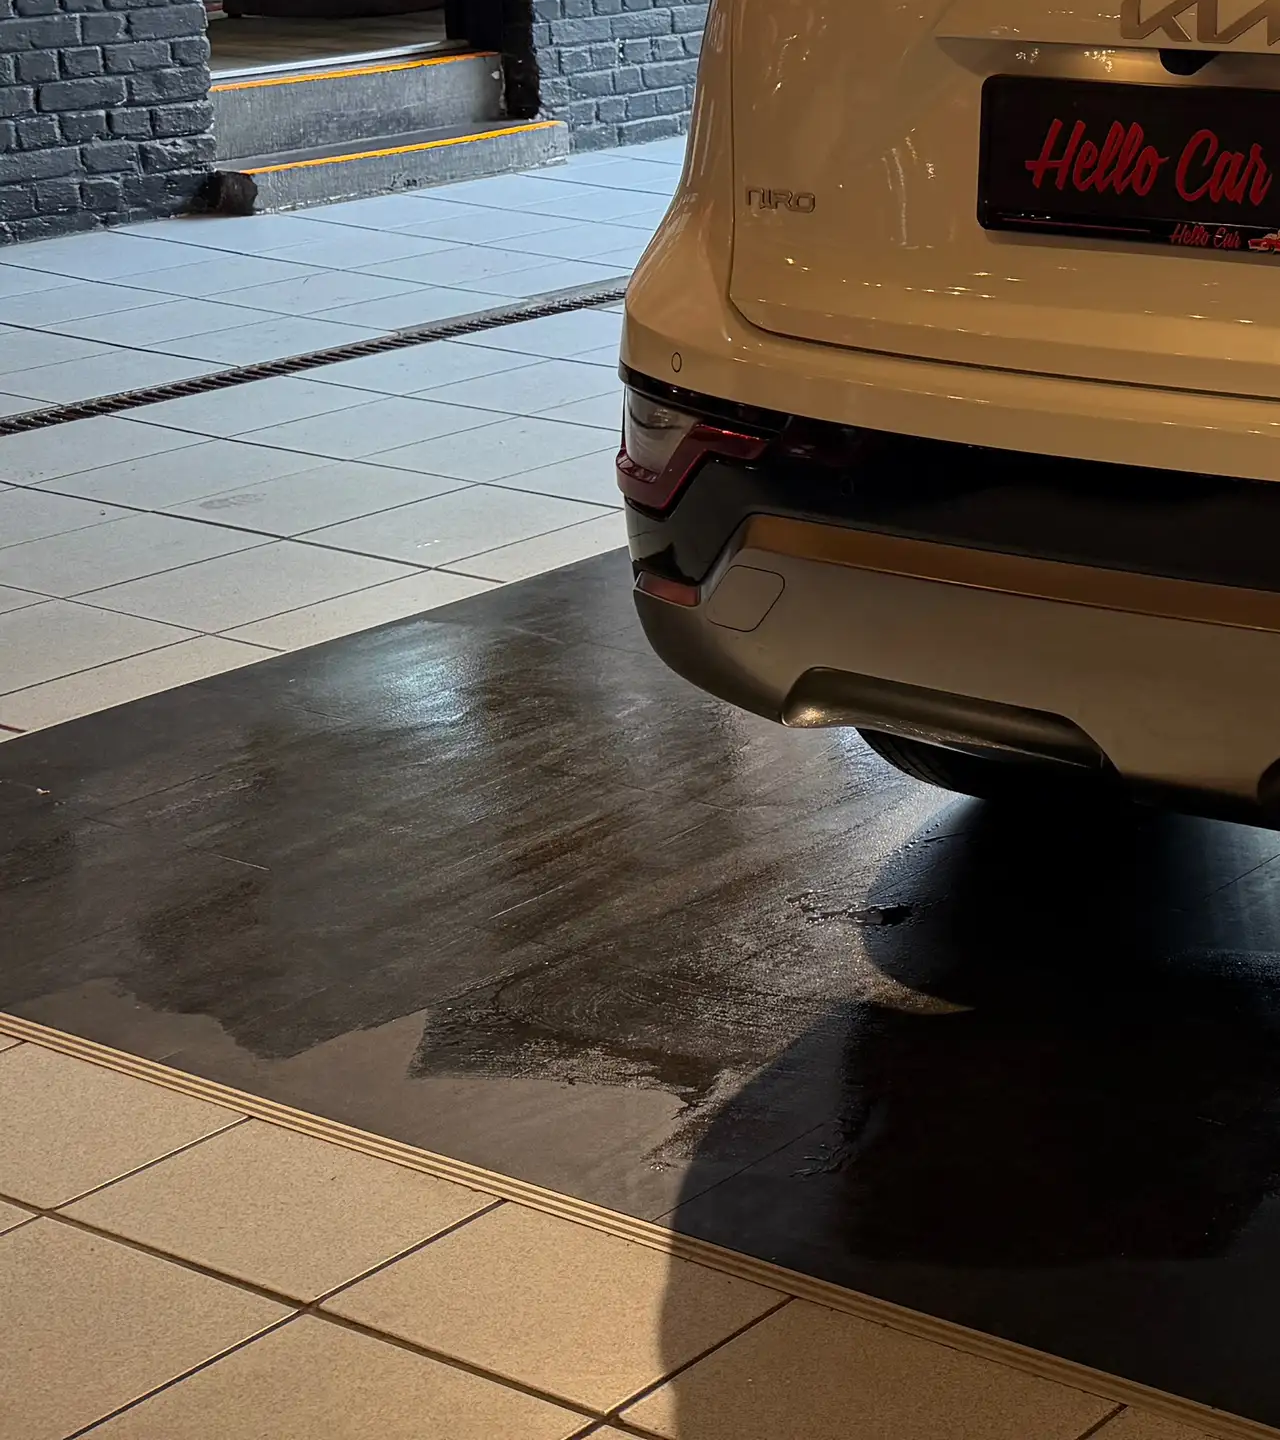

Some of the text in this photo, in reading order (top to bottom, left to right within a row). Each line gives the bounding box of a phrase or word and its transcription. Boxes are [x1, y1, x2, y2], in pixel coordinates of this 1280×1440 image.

[1025, 118, 1274, 207] Hello Car
[745, 186, 816, 214] NIRO
[1169, 223, 1241, 250] Hello Car
